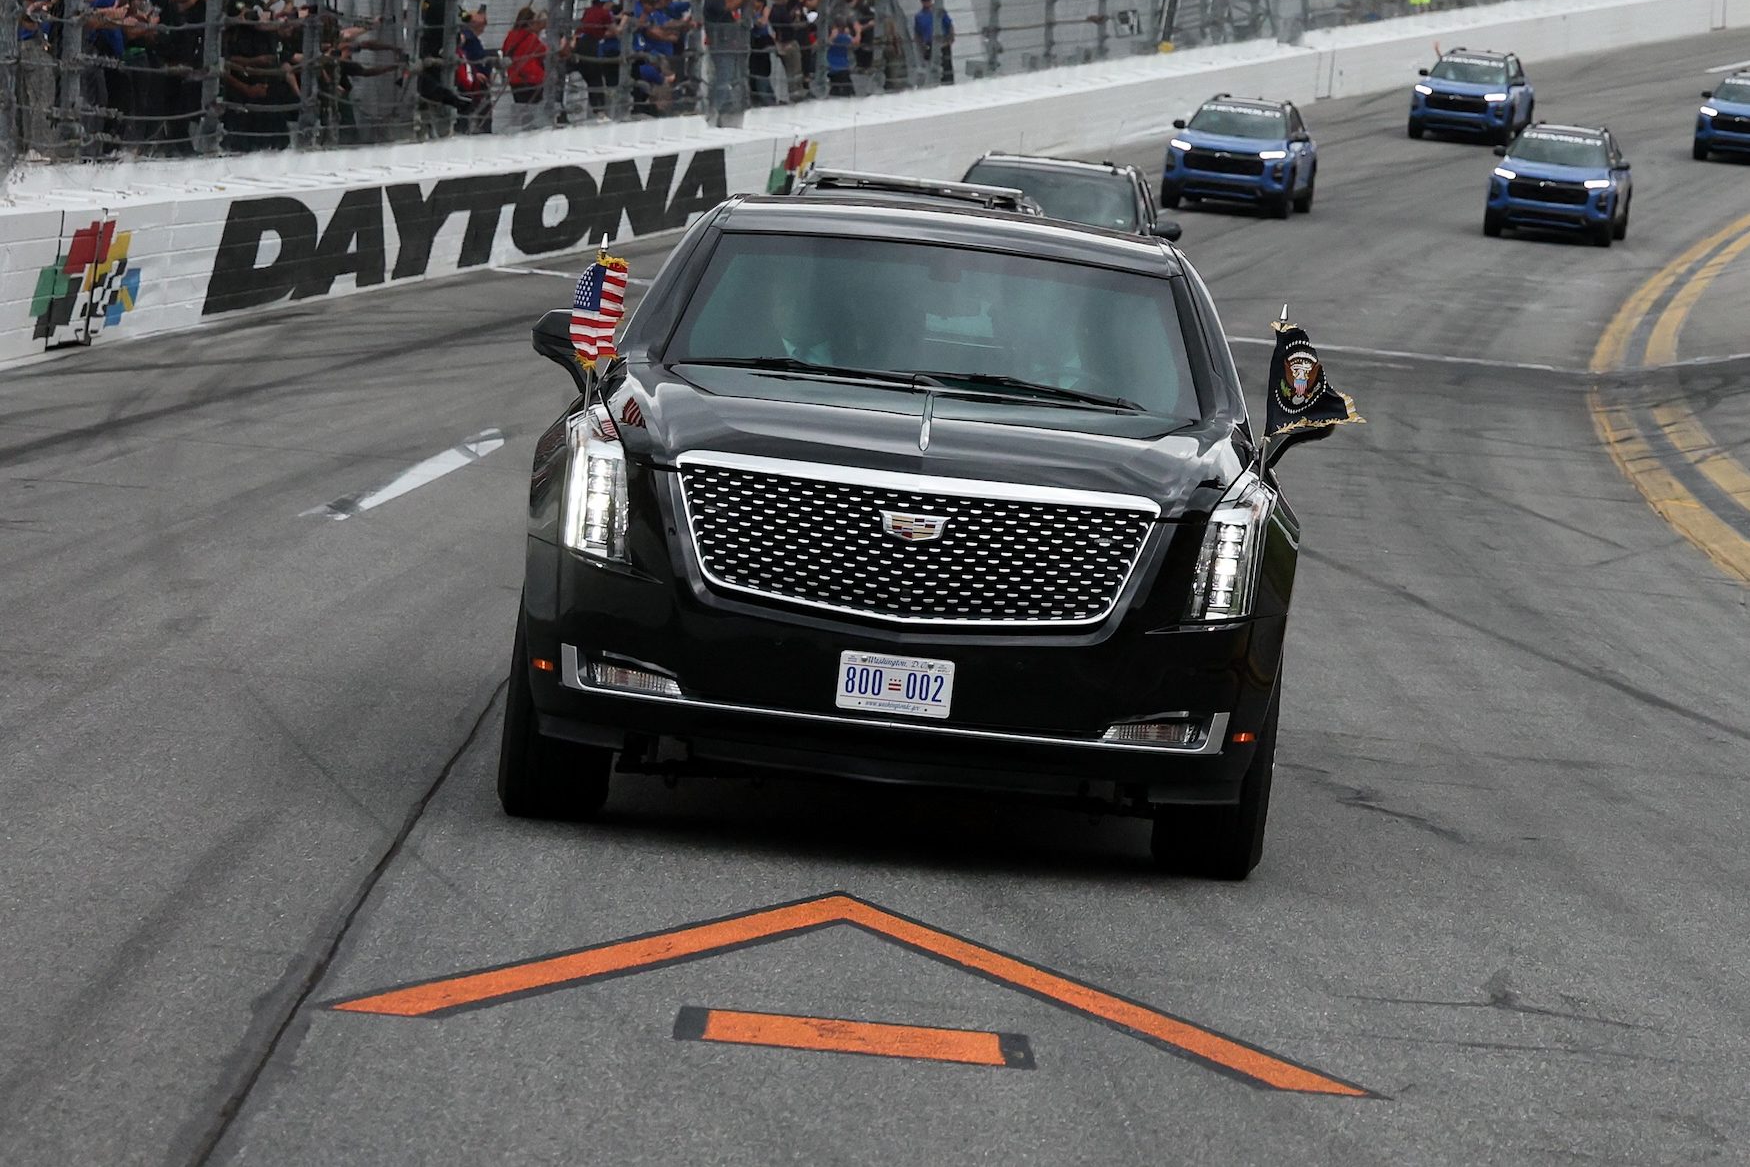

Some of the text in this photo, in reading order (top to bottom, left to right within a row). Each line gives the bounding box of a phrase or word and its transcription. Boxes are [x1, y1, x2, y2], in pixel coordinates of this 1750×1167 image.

[201, 148, 728, 316] DAYTONA
[845, 666, 944, 703] 800 002
